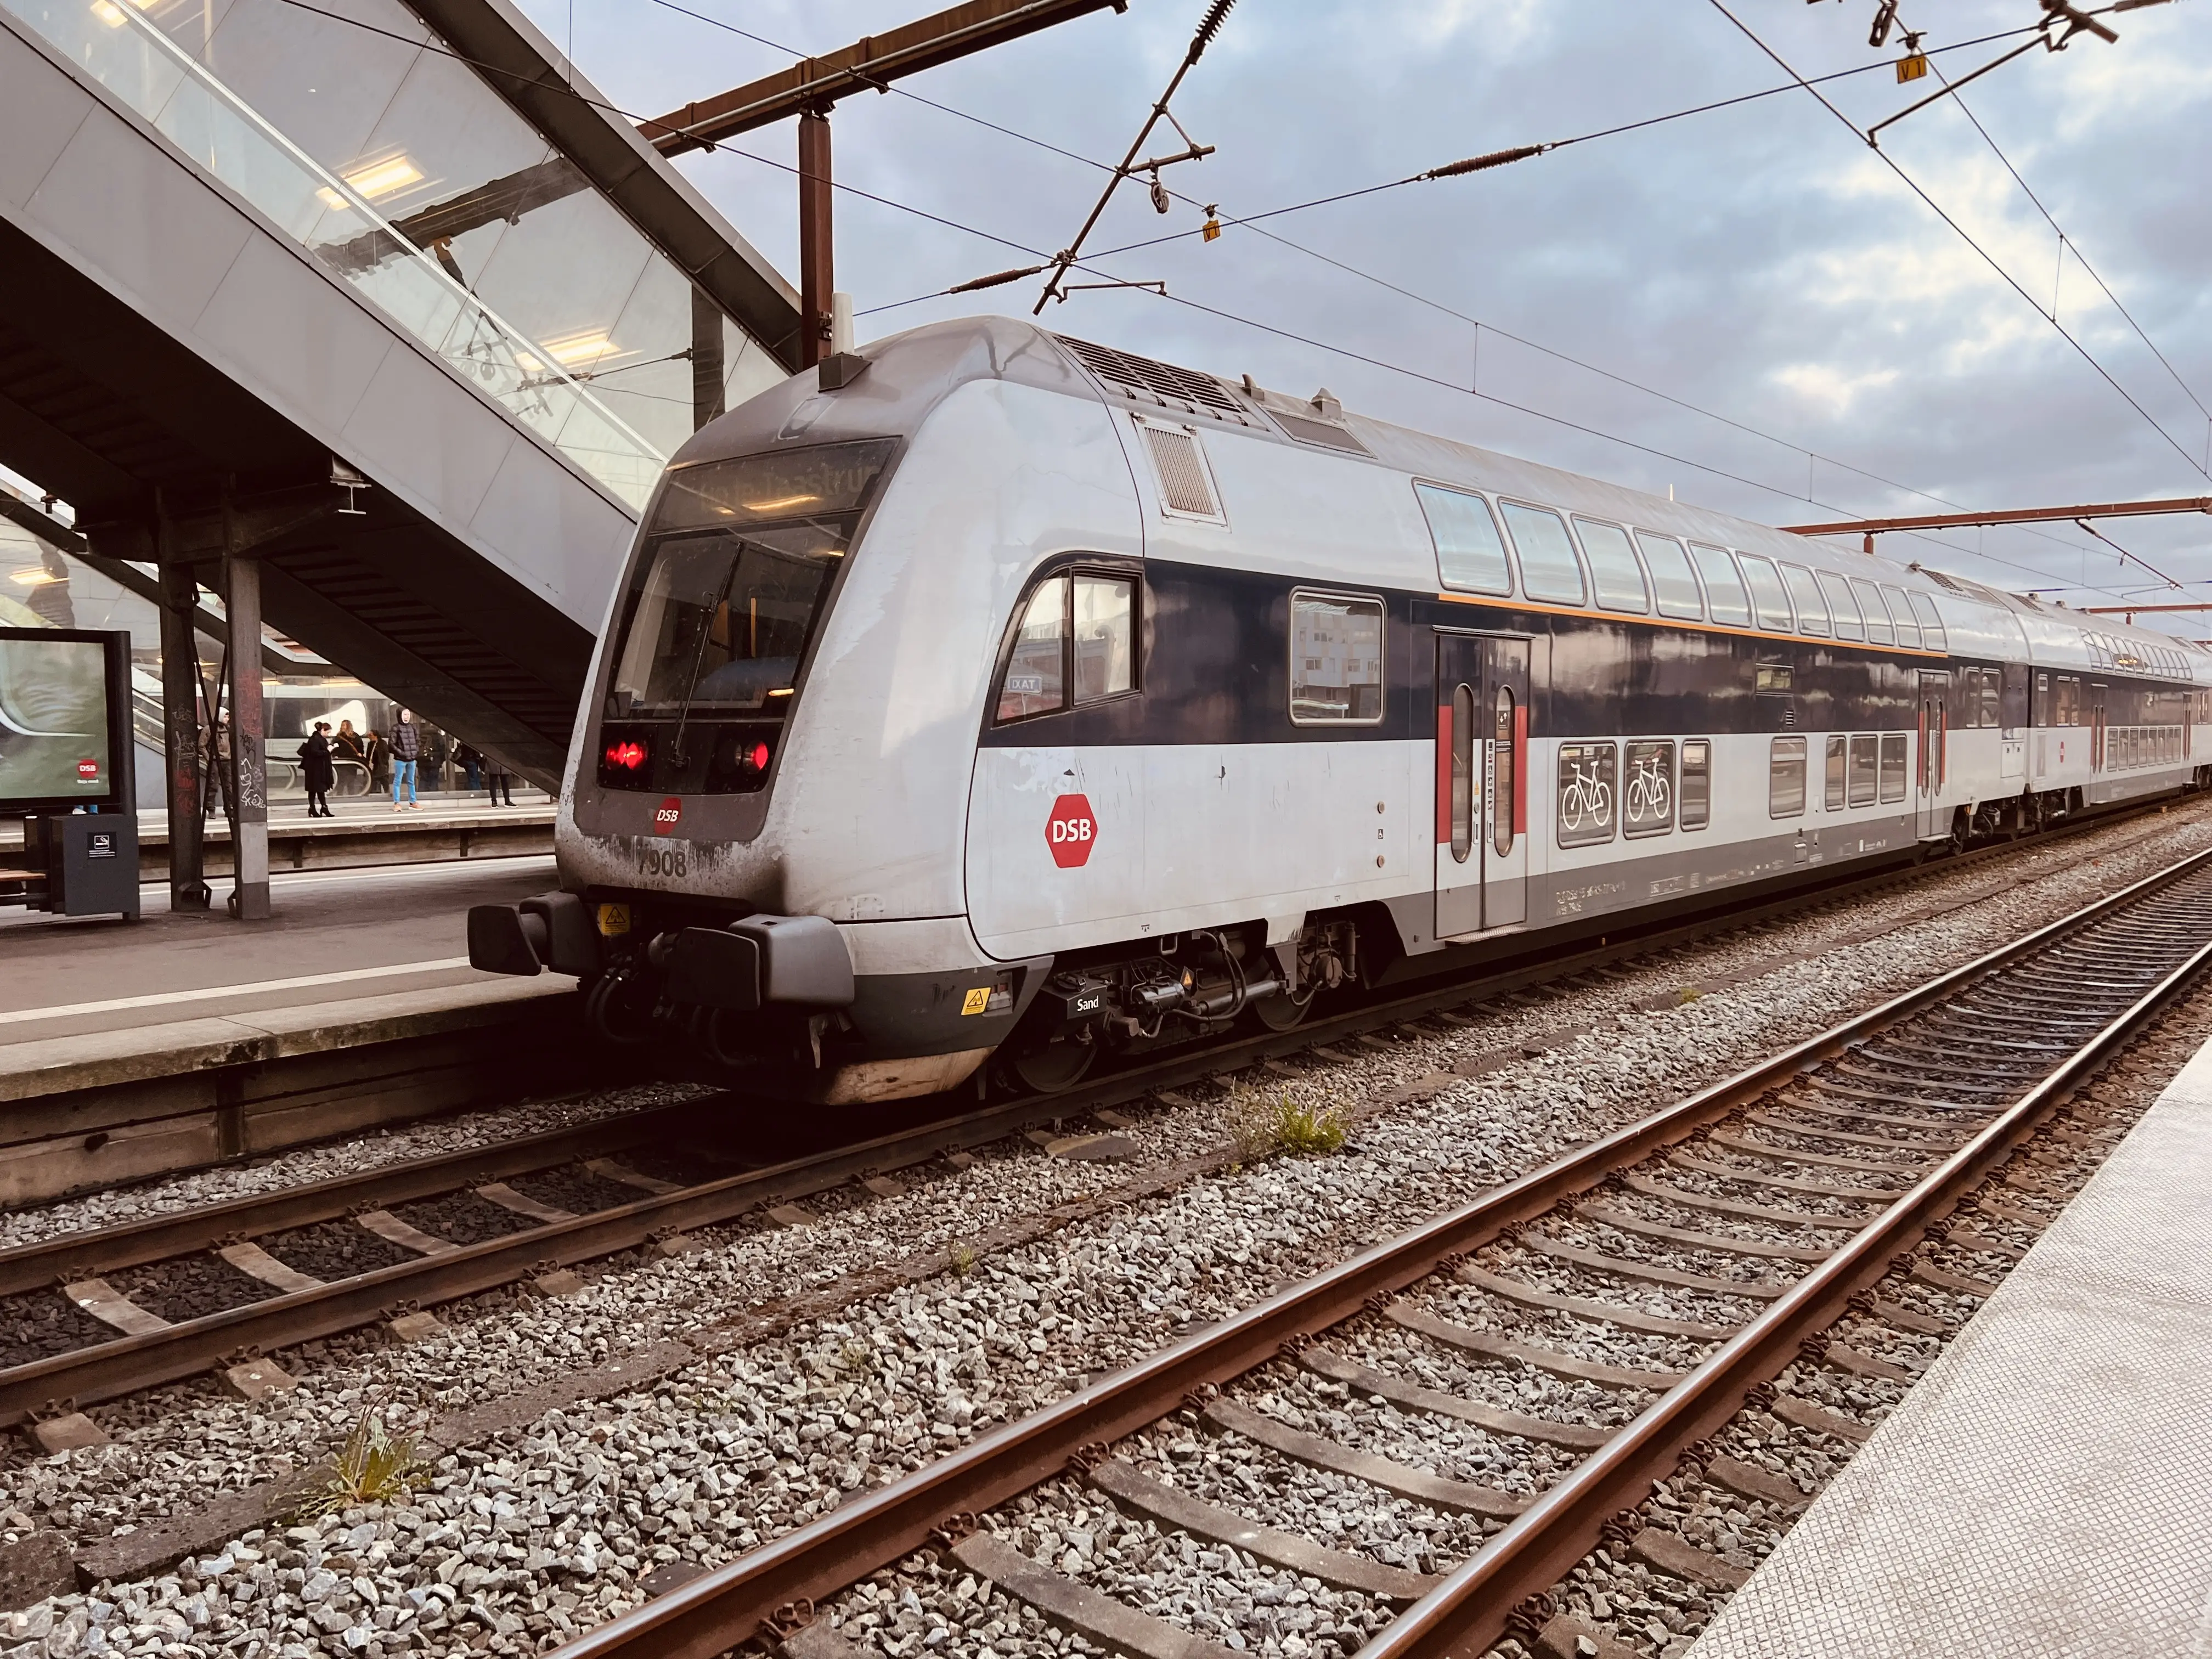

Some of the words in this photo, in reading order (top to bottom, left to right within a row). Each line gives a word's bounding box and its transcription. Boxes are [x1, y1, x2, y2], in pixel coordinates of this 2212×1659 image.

[657, 809, 679, 822] DSB
[1053, 819, 1091, 843] DSB
[636, 849, 687, 877] 7908
[1077, 995, 1099, 1011] Sand
